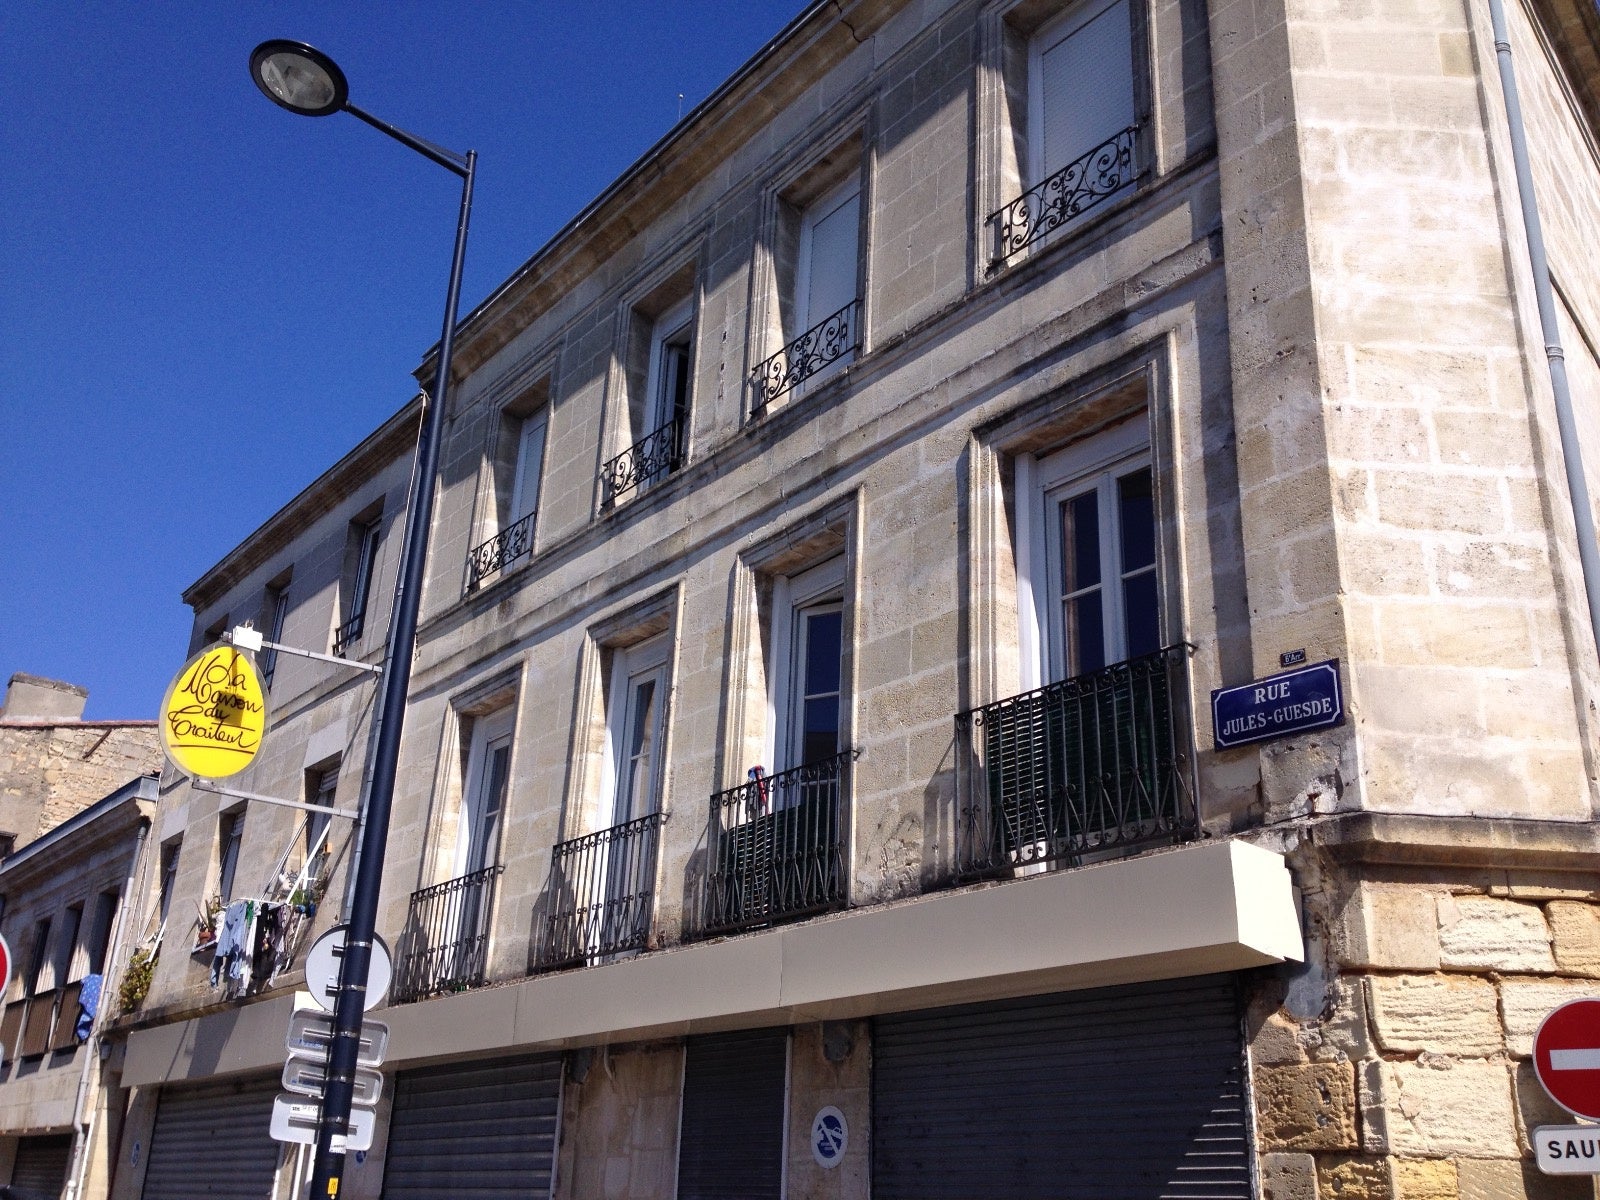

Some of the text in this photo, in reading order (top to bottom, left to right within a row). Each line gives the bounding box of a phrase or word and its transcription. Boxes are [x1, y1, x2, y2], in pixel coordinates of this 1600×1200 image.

[181, 655, 263, 713] Maison
[207, 653, 247, 691] La
[204, 703, 230, 720] du
[1254, 681, 1291, 705] RUE
[168, 705, 259, 749] Traiteur
[1223, 697, 1333, 736] JULES-GUESDE
[1547, 1139, 1600, 1159] SAU
